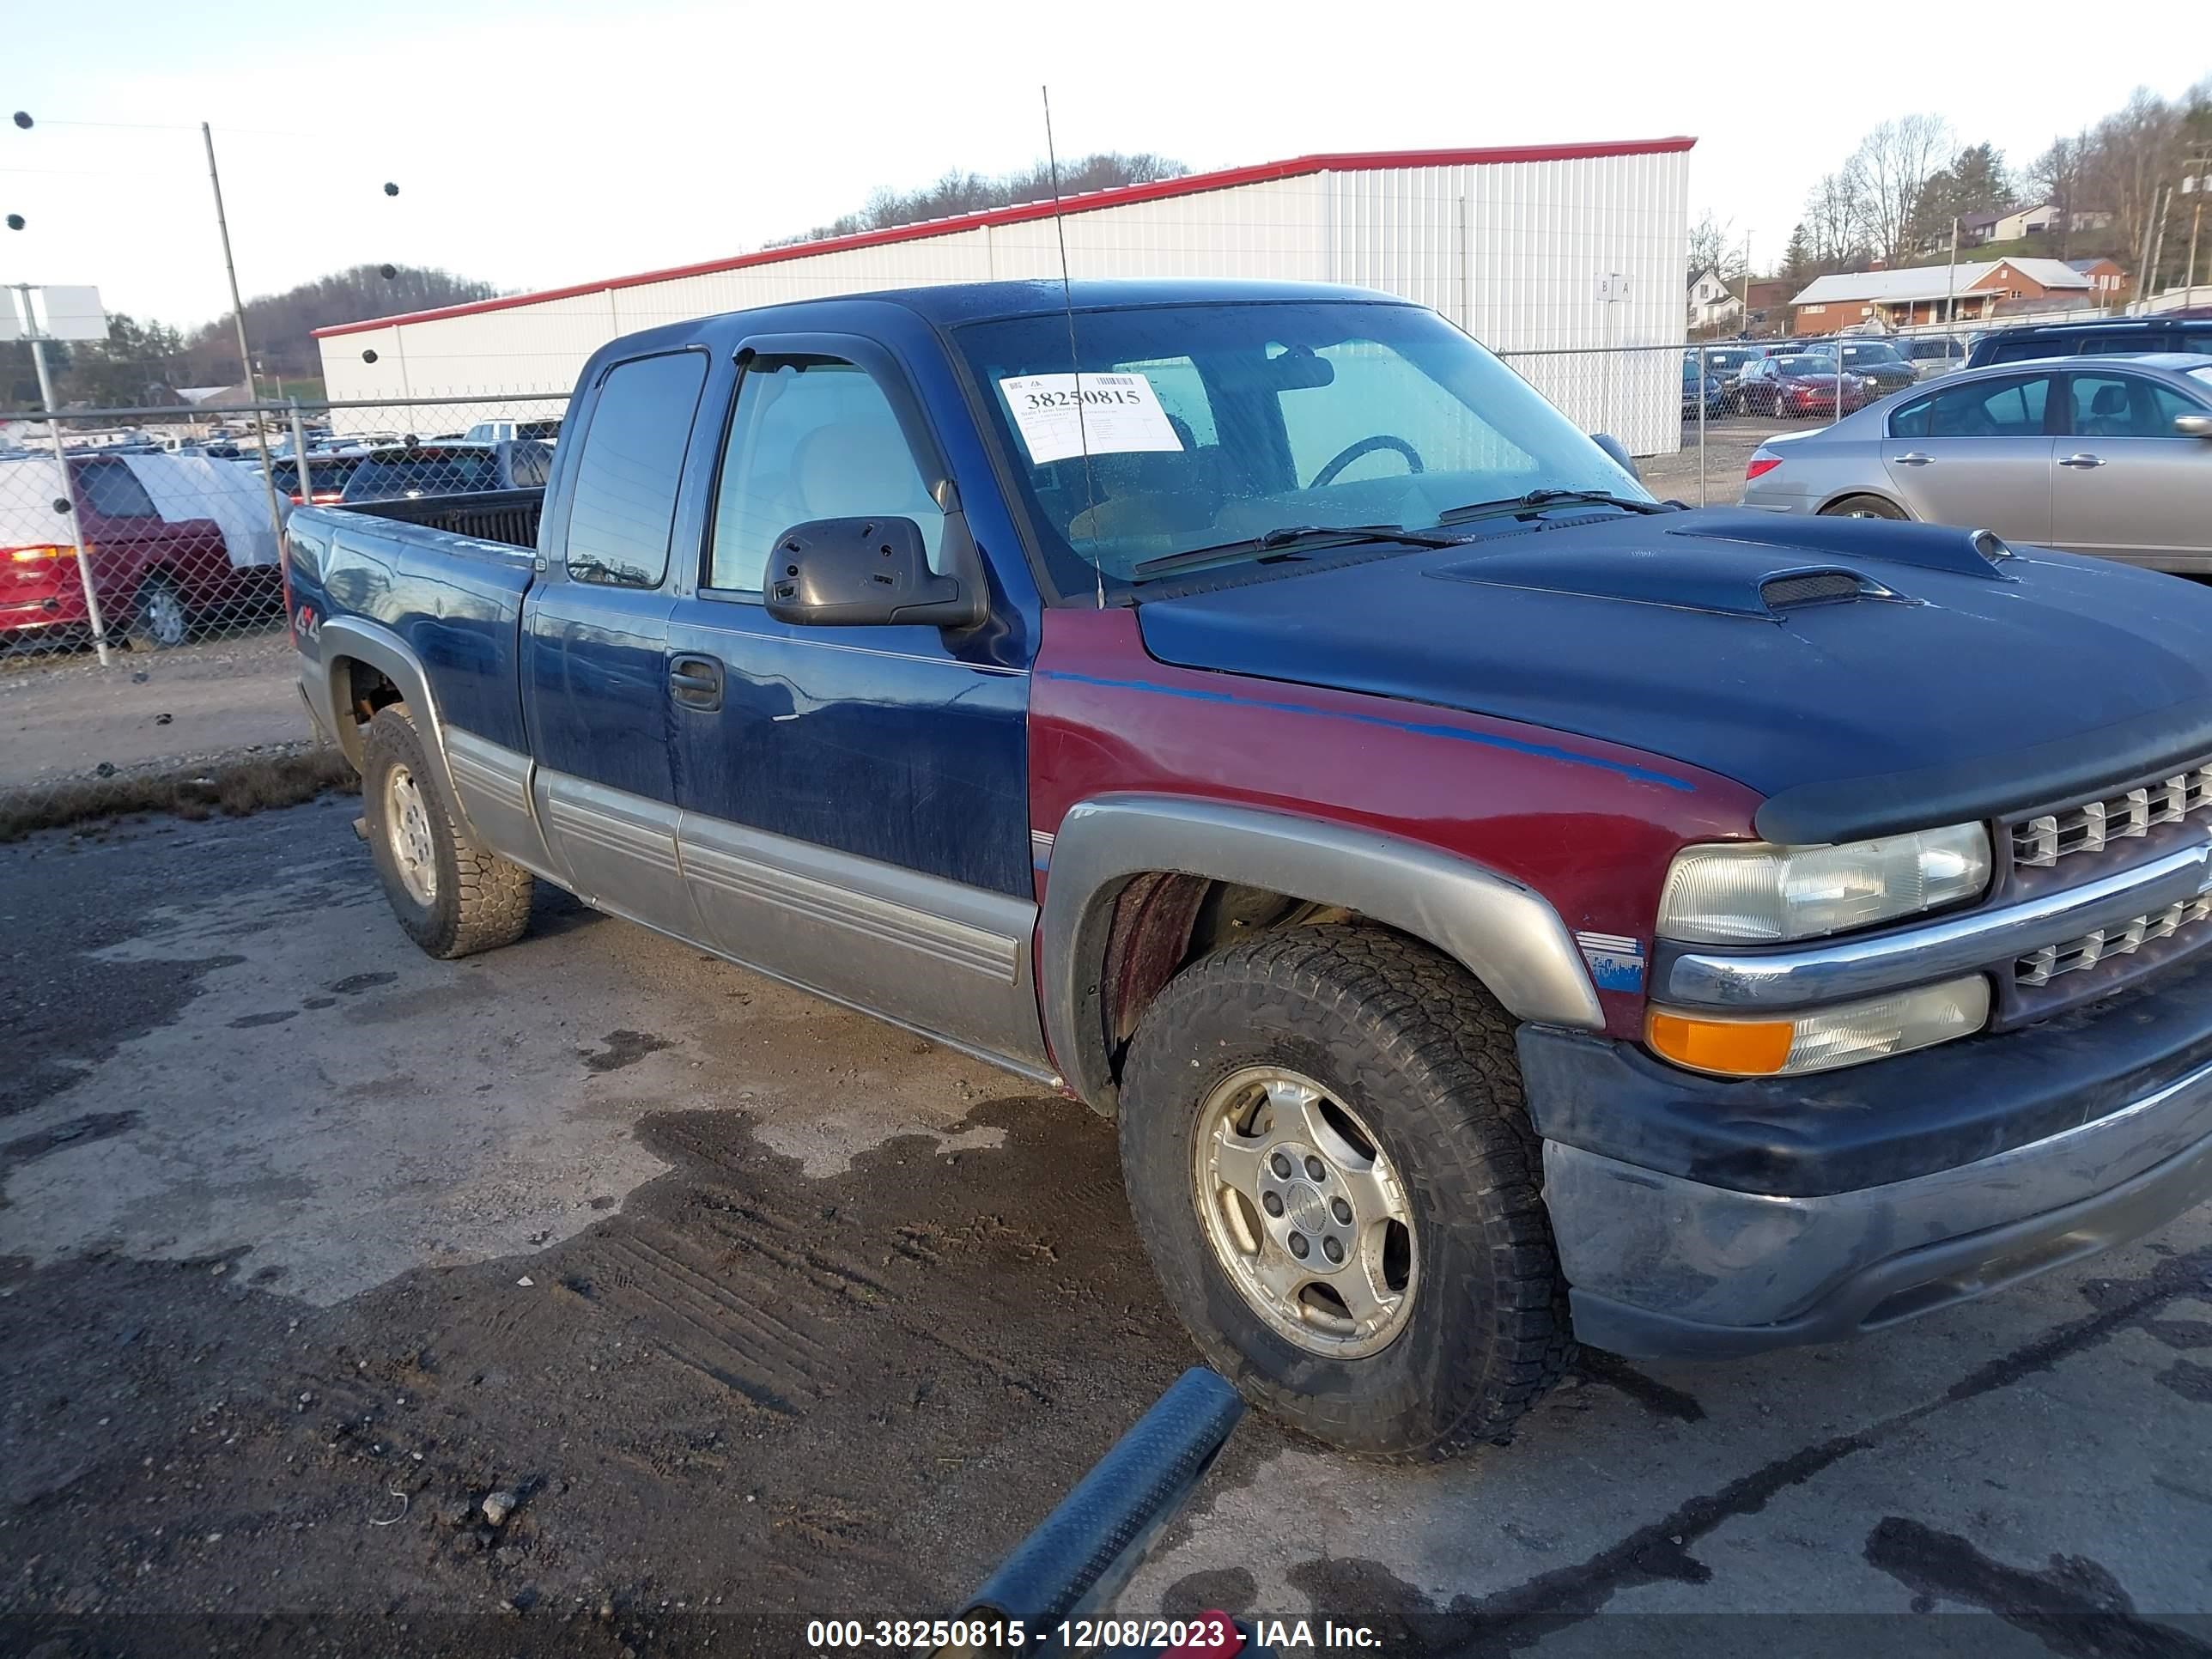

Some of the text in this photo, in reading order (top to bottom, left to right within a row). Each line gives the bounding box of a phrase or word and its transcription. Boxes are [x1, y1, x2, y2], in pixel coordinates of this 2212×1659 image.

[1602, 281, 1607, 292] B
[1622, 283, 1629, 294] A
[1024, 390, 1140, 410] 38250815
